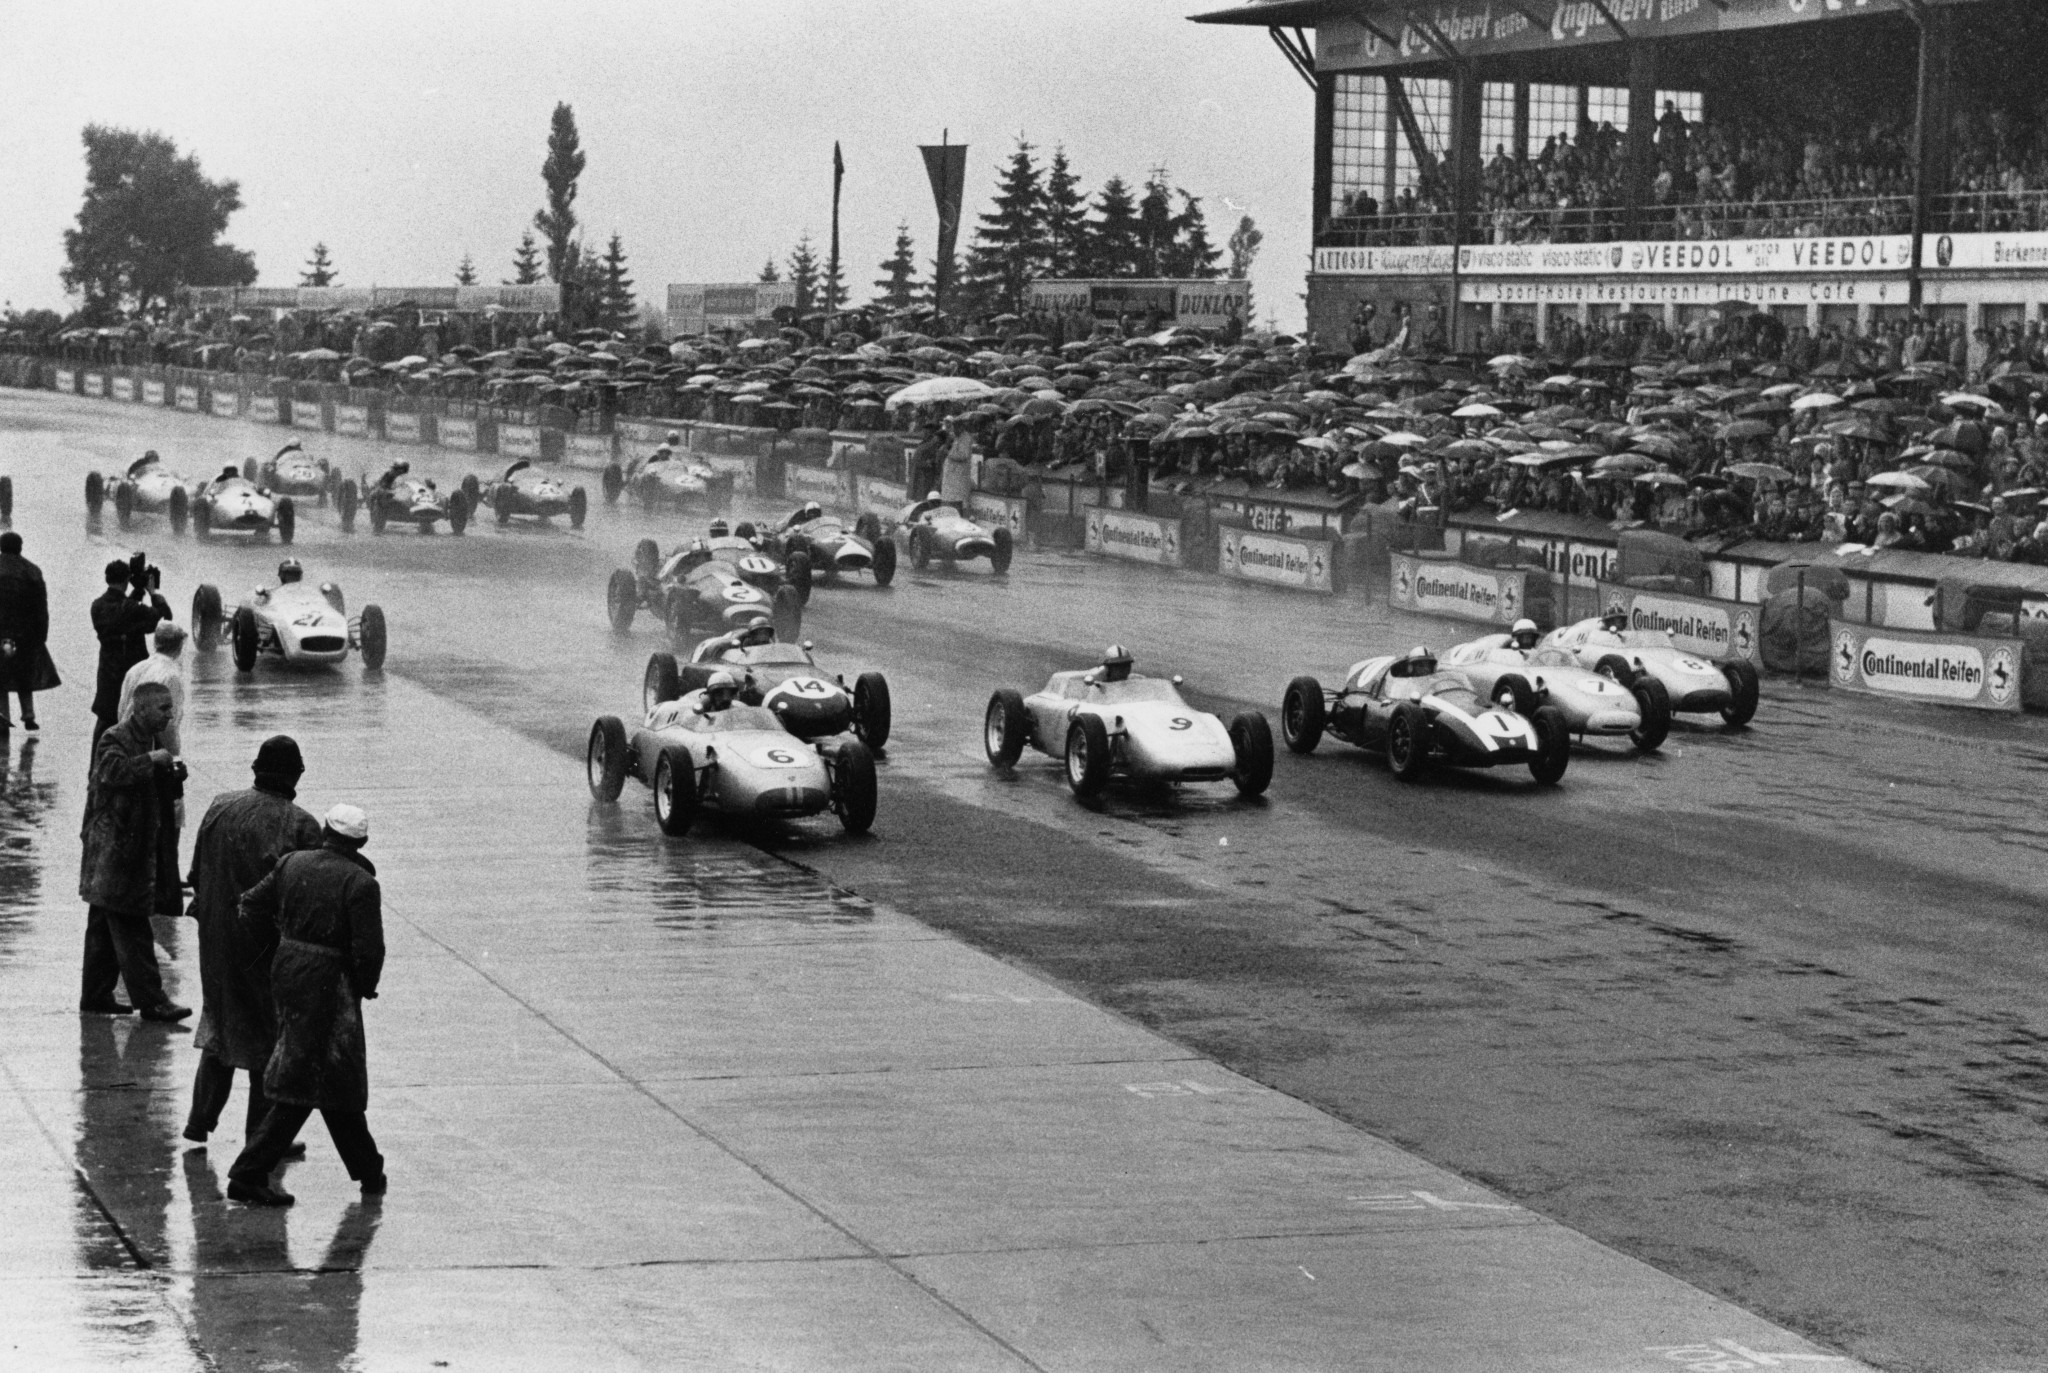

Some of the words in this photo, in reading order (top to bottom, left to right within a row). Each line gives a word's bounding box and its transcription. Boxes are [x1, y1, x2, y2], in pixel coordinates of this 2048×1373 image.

[1647, 244, 1733, 268] VEEDOL
[1793, 240, 1888, 265] VEEDOL
[1180, 294, 1243, 315] DUNLOP
[747, 559, 767, 570] 11
[1241, 546, 1284, 569] Continental
[1286, 554, 1308, 574] Reifen
[1416, 576, 1469, 600] Continental
[1470, 584, 1497, 606] Reifen
[1632, 607, 1695, 637] Continental
[1696, 618, 1728, 642] Reifen
[1862, 650, 1940, 681] Continental
[1941, 658, 1981, 684] Reifen
[791, 680, 826, 694] 14
[1168, 717, 1193, 731] 9
[1494, 714, 1510, 732] 1
[766, 750, 795, 764] 6
